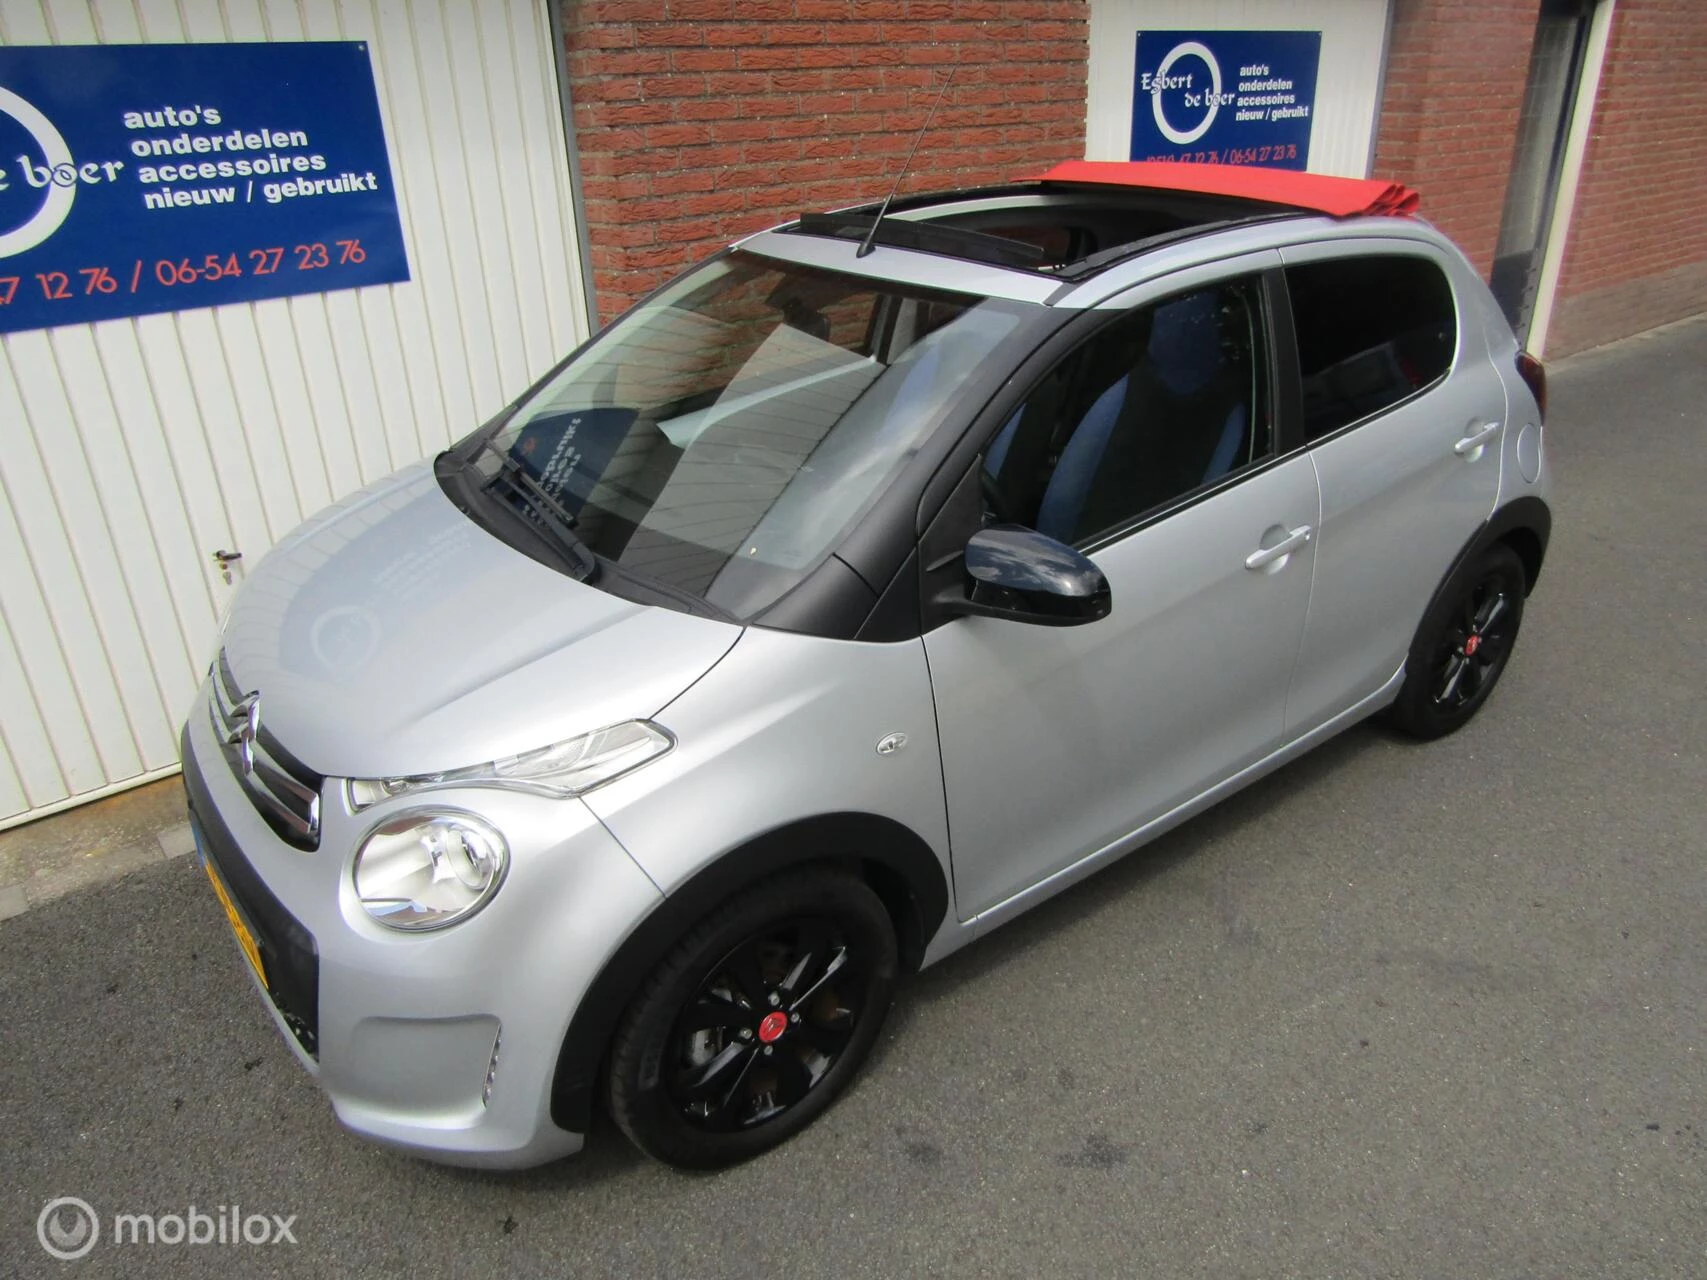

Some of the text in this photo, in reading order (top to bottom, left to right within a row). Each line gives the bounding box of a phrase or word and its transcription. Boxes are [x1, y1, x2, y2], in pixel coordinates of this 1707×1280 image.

[1141, 69, 1192, 95] Egbert
[1239, 64, 1269, 76] auto's
[1238, 78, 1293, 92] onderdelen
[1184, 88, 1235, 108] de boer
[1237, 92, 1296, 107] accessoires
[123, 104, 222, 129] auto's
[1235, 105, 1309, 122] nieuw / gebruikt
[131, 128, 309, 158] onderdelen
[1230, 147, 1256, 164] 06-54
[1259, 146, 1272, 162] 27
[1273, 145, 1285, 160] 23
[1286, 144, 1297, 159] 76
[16, 154, 125, 188] boer
[138, 152, 327, 184] accessoires
[144, 171, 378, 209] nieuw / gebruikt
[35, 271, 74, 300] 12
[79, 267, 119, 296] 76
[131, 260, 143, 294] /
[155, 252, 242, 286] 06-54
[249, 247, 285, 275] 27
[294, 243, 329, 270] 23
[336, 239, 366, 265] 76
